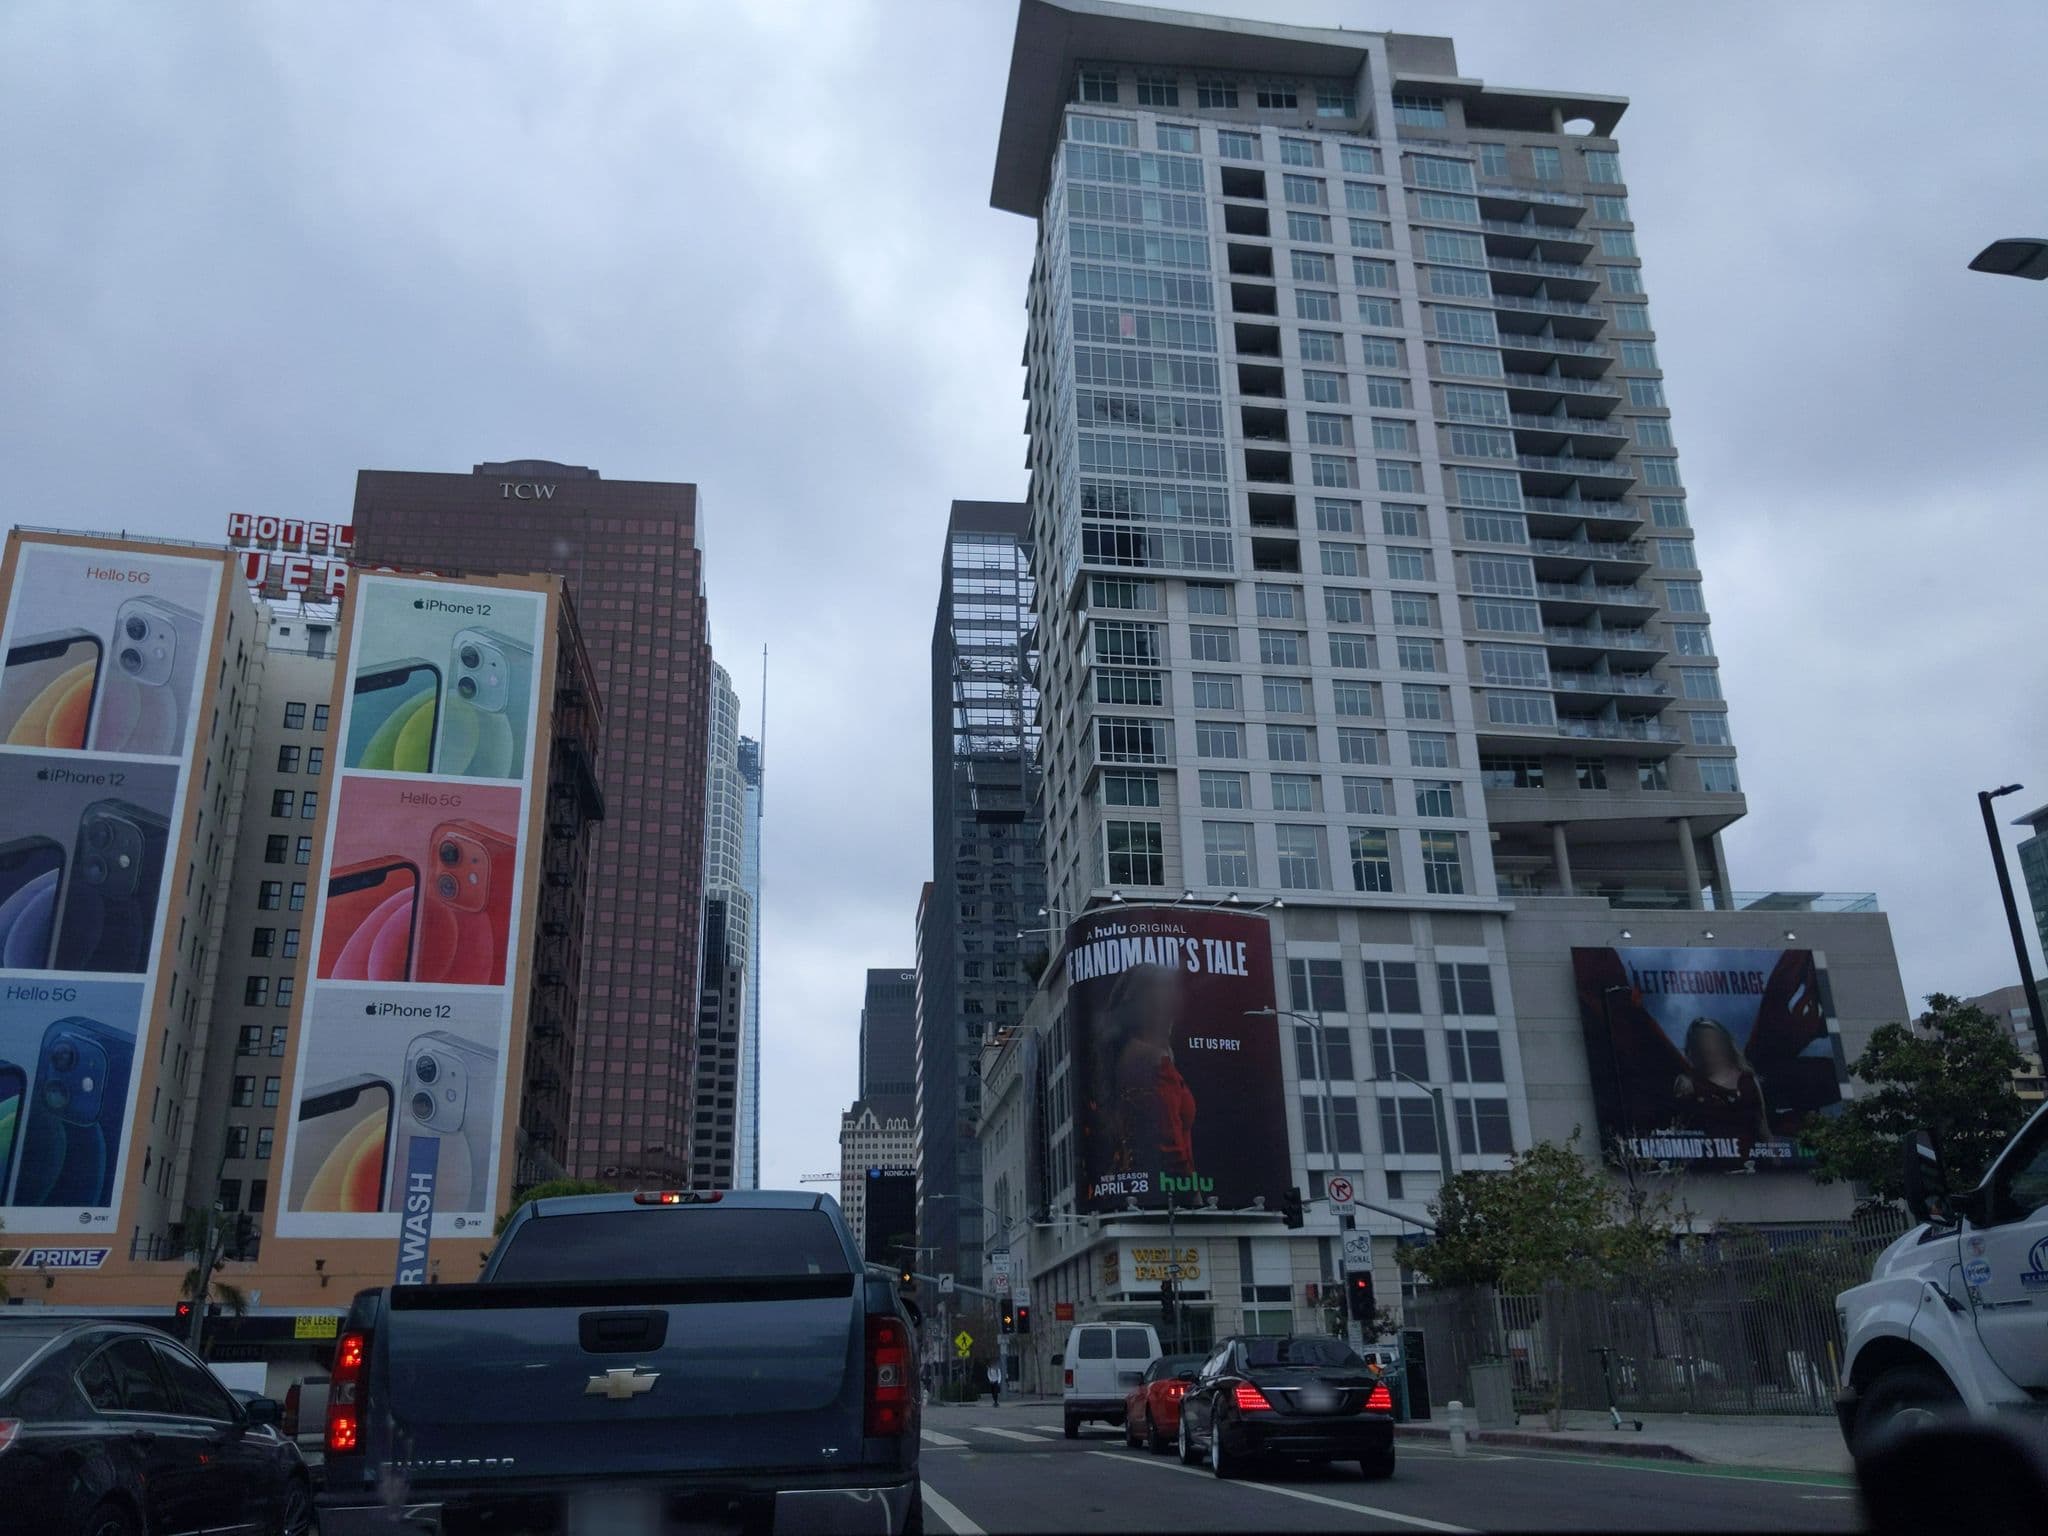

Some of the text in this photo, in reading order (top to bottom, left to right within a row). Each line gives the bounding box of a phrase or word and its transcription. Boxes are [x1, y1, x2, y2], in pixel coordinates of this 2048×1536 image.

[500, 482, 558, 500] TCW
[229, 514, 354, 548] HOTEL
[86, 567, 150, 584] Hello 5G
[425, 599, 492, 617] iPhone 12
[50, 768, 126, 786] iPhone 12
[400, 791, 462, 808] Hello 5G
[1086, 922, 1188, 942] A hulu ORIGINAL
[1074, 936, 1201, 984] HANDMAID'S
[1202, 938, 1249, 977] TALE
[1638, 970, 1767, 995] LET FREEDOM RAGE
[7, 986, 77, 1002] Hello 5G
[378, 1002, 452, 1019] iPhone 12
[1188, 1037, 1242, 1051] LET US PREY
[1713, 1137, 1742, 1158] TALE
[1749, 1148, 1776, 1158] APRIL
[1100, 1171, 1149, 1182] NEW SEASON
[1159, 1170, 1214, 1192] hulu
[1093, 1179, 1149, 1198] APRIL 28
[402, 1172, 433, 1264] WASH
[31, 1249, 101, 1266] PRIME
[1131, 1247, 1200, 1263] WELLS
[297, 1315, 337, 1327] FOR LEASE
